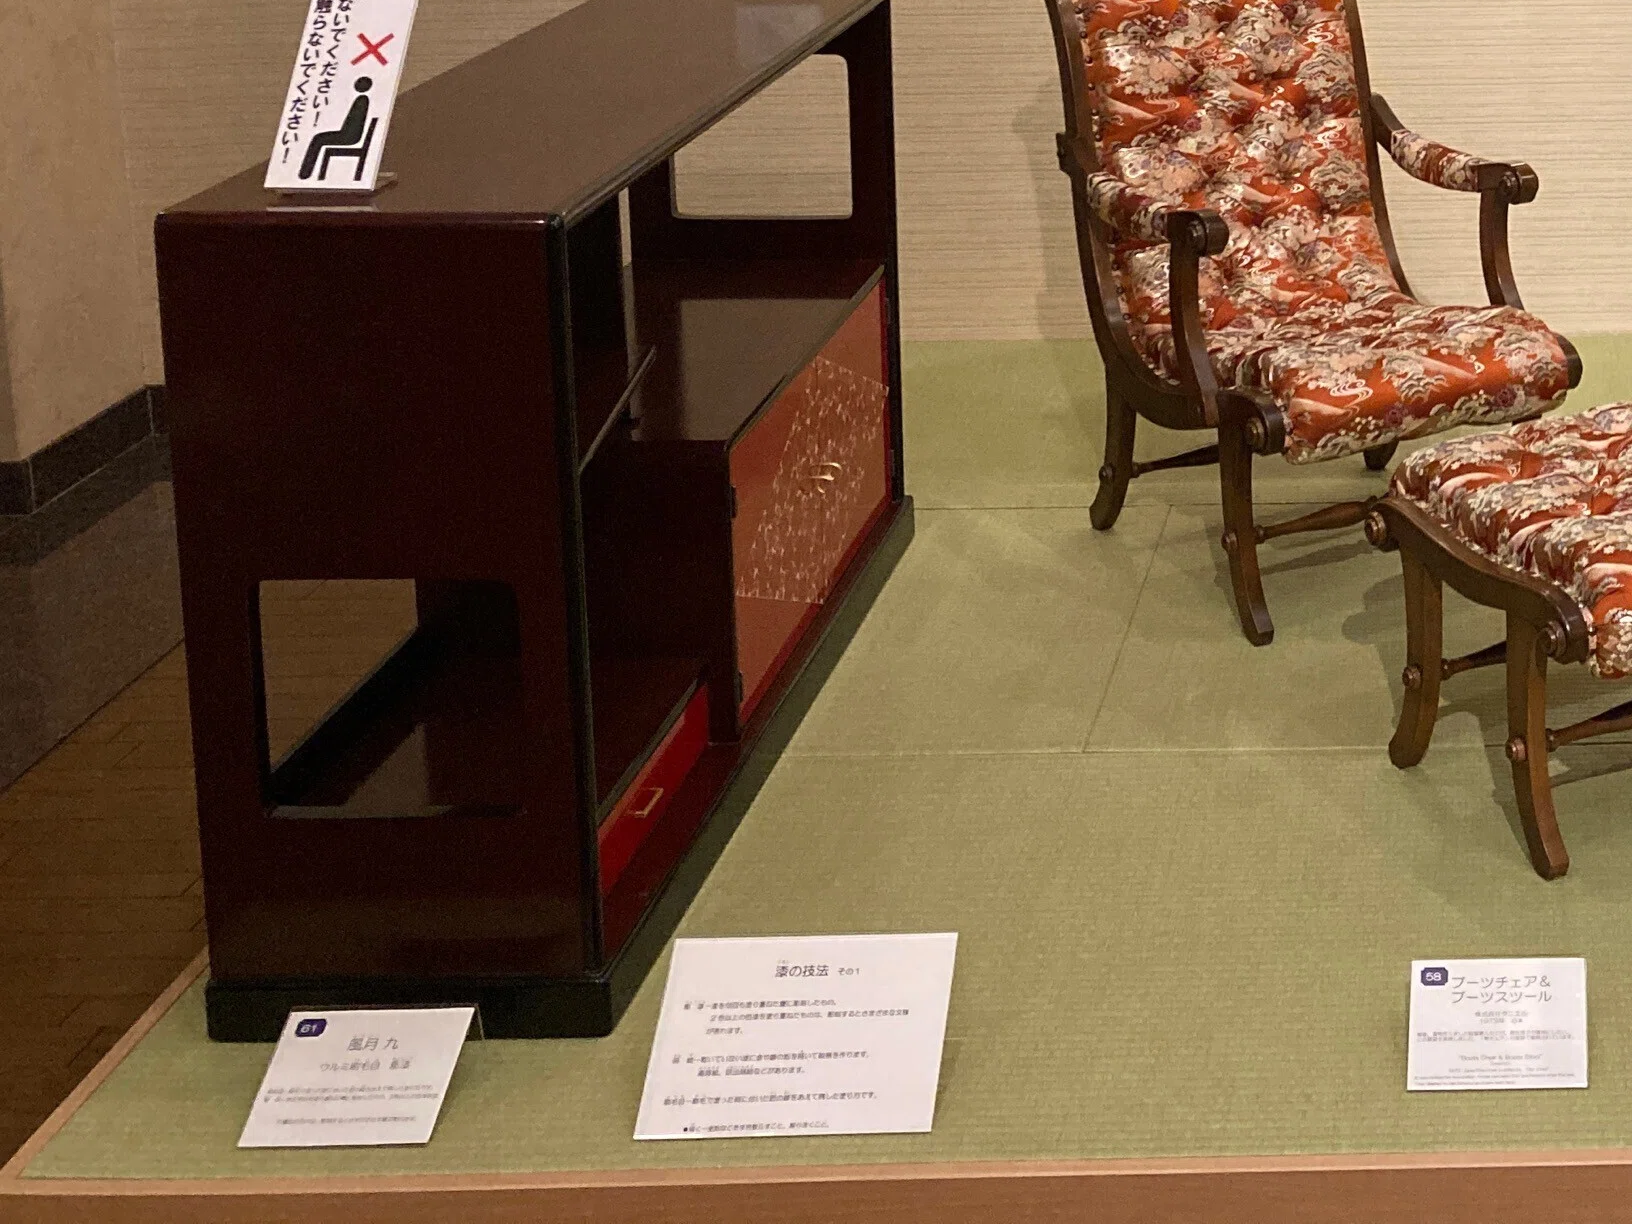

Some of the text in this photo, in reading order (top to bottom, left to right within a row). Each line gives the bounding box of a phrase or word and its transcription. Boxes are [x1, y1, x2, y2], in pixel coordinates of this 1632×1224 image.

[1451, 991, 1553, 1004] ブーツスツール
